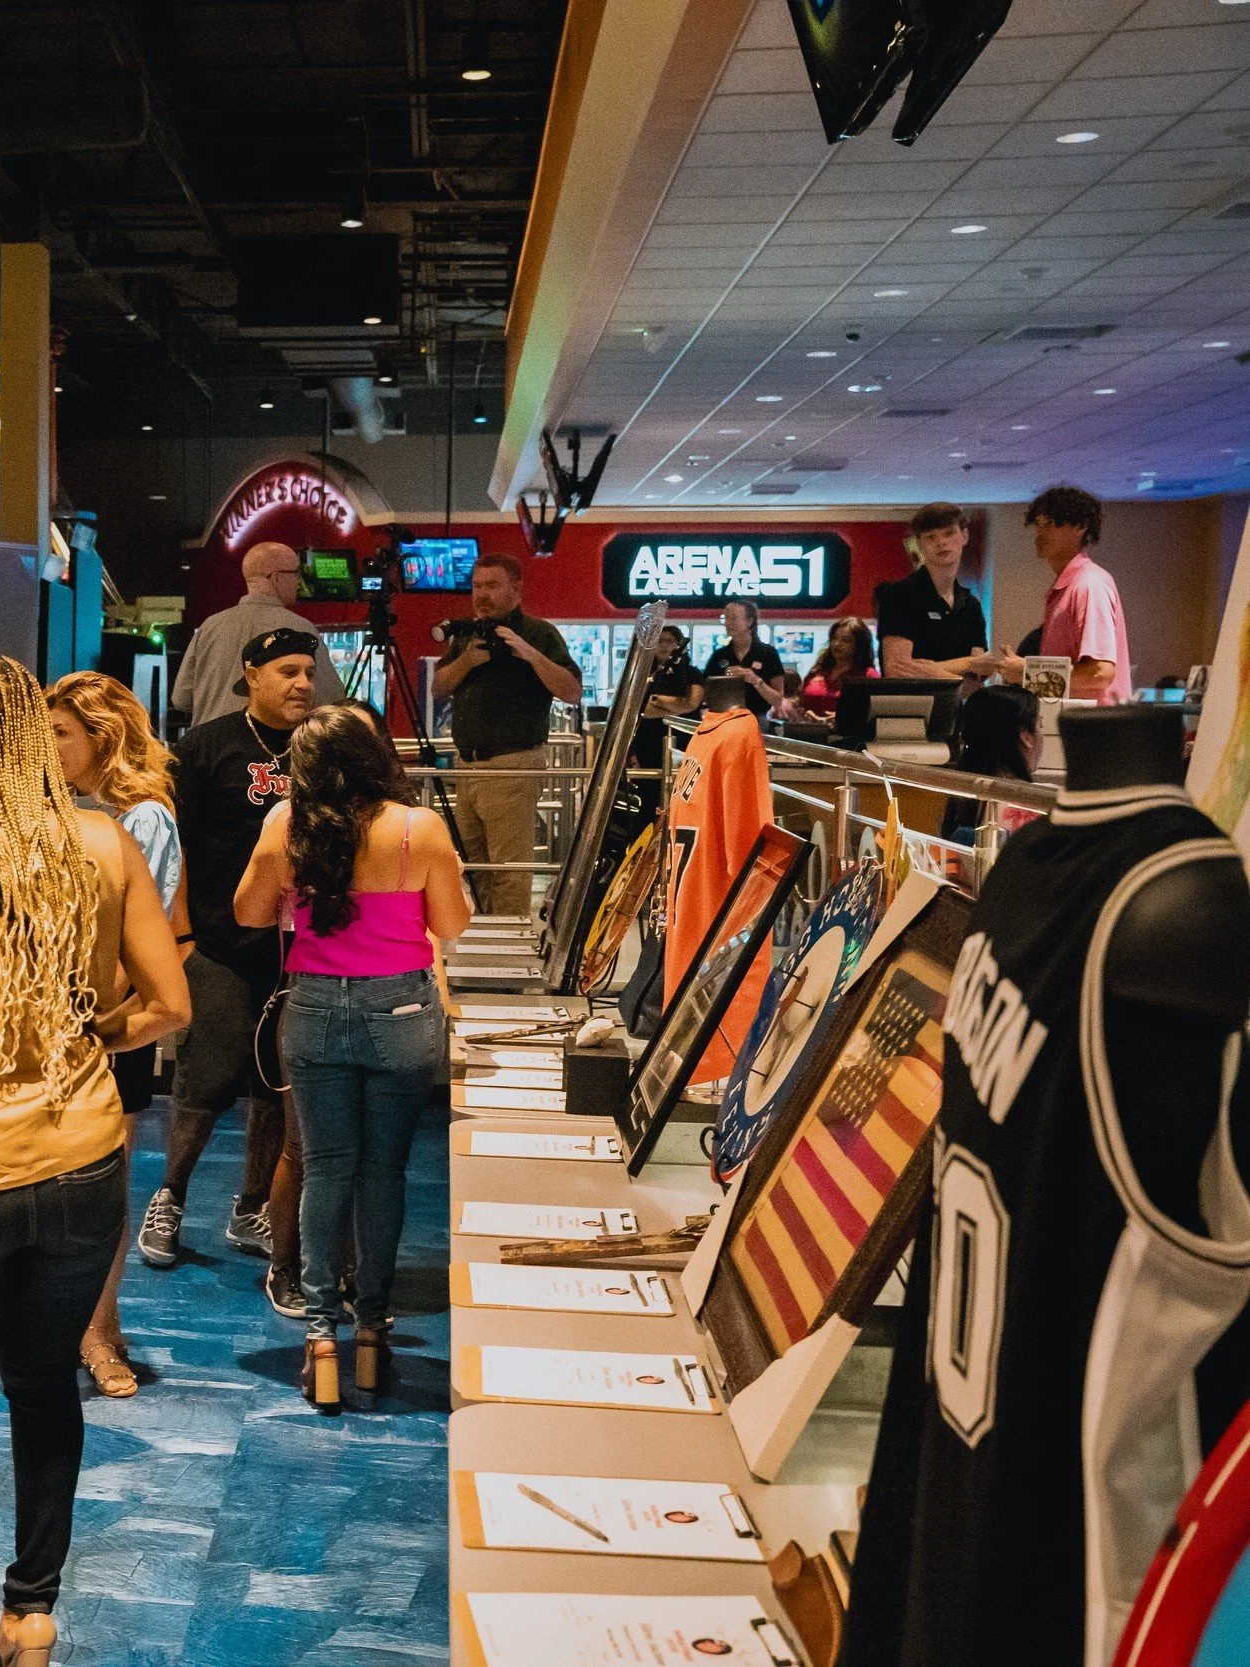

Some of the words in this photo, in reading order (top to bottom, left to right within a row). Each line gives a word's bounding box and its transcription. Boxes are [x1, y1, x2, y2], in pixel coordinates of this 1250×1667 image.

[629, 545, 762, 579] ARENA
[759, 545, 825, 597] 51
[629, 576, 704, 596] LASER
[708, 576, 763, 596] TAG
